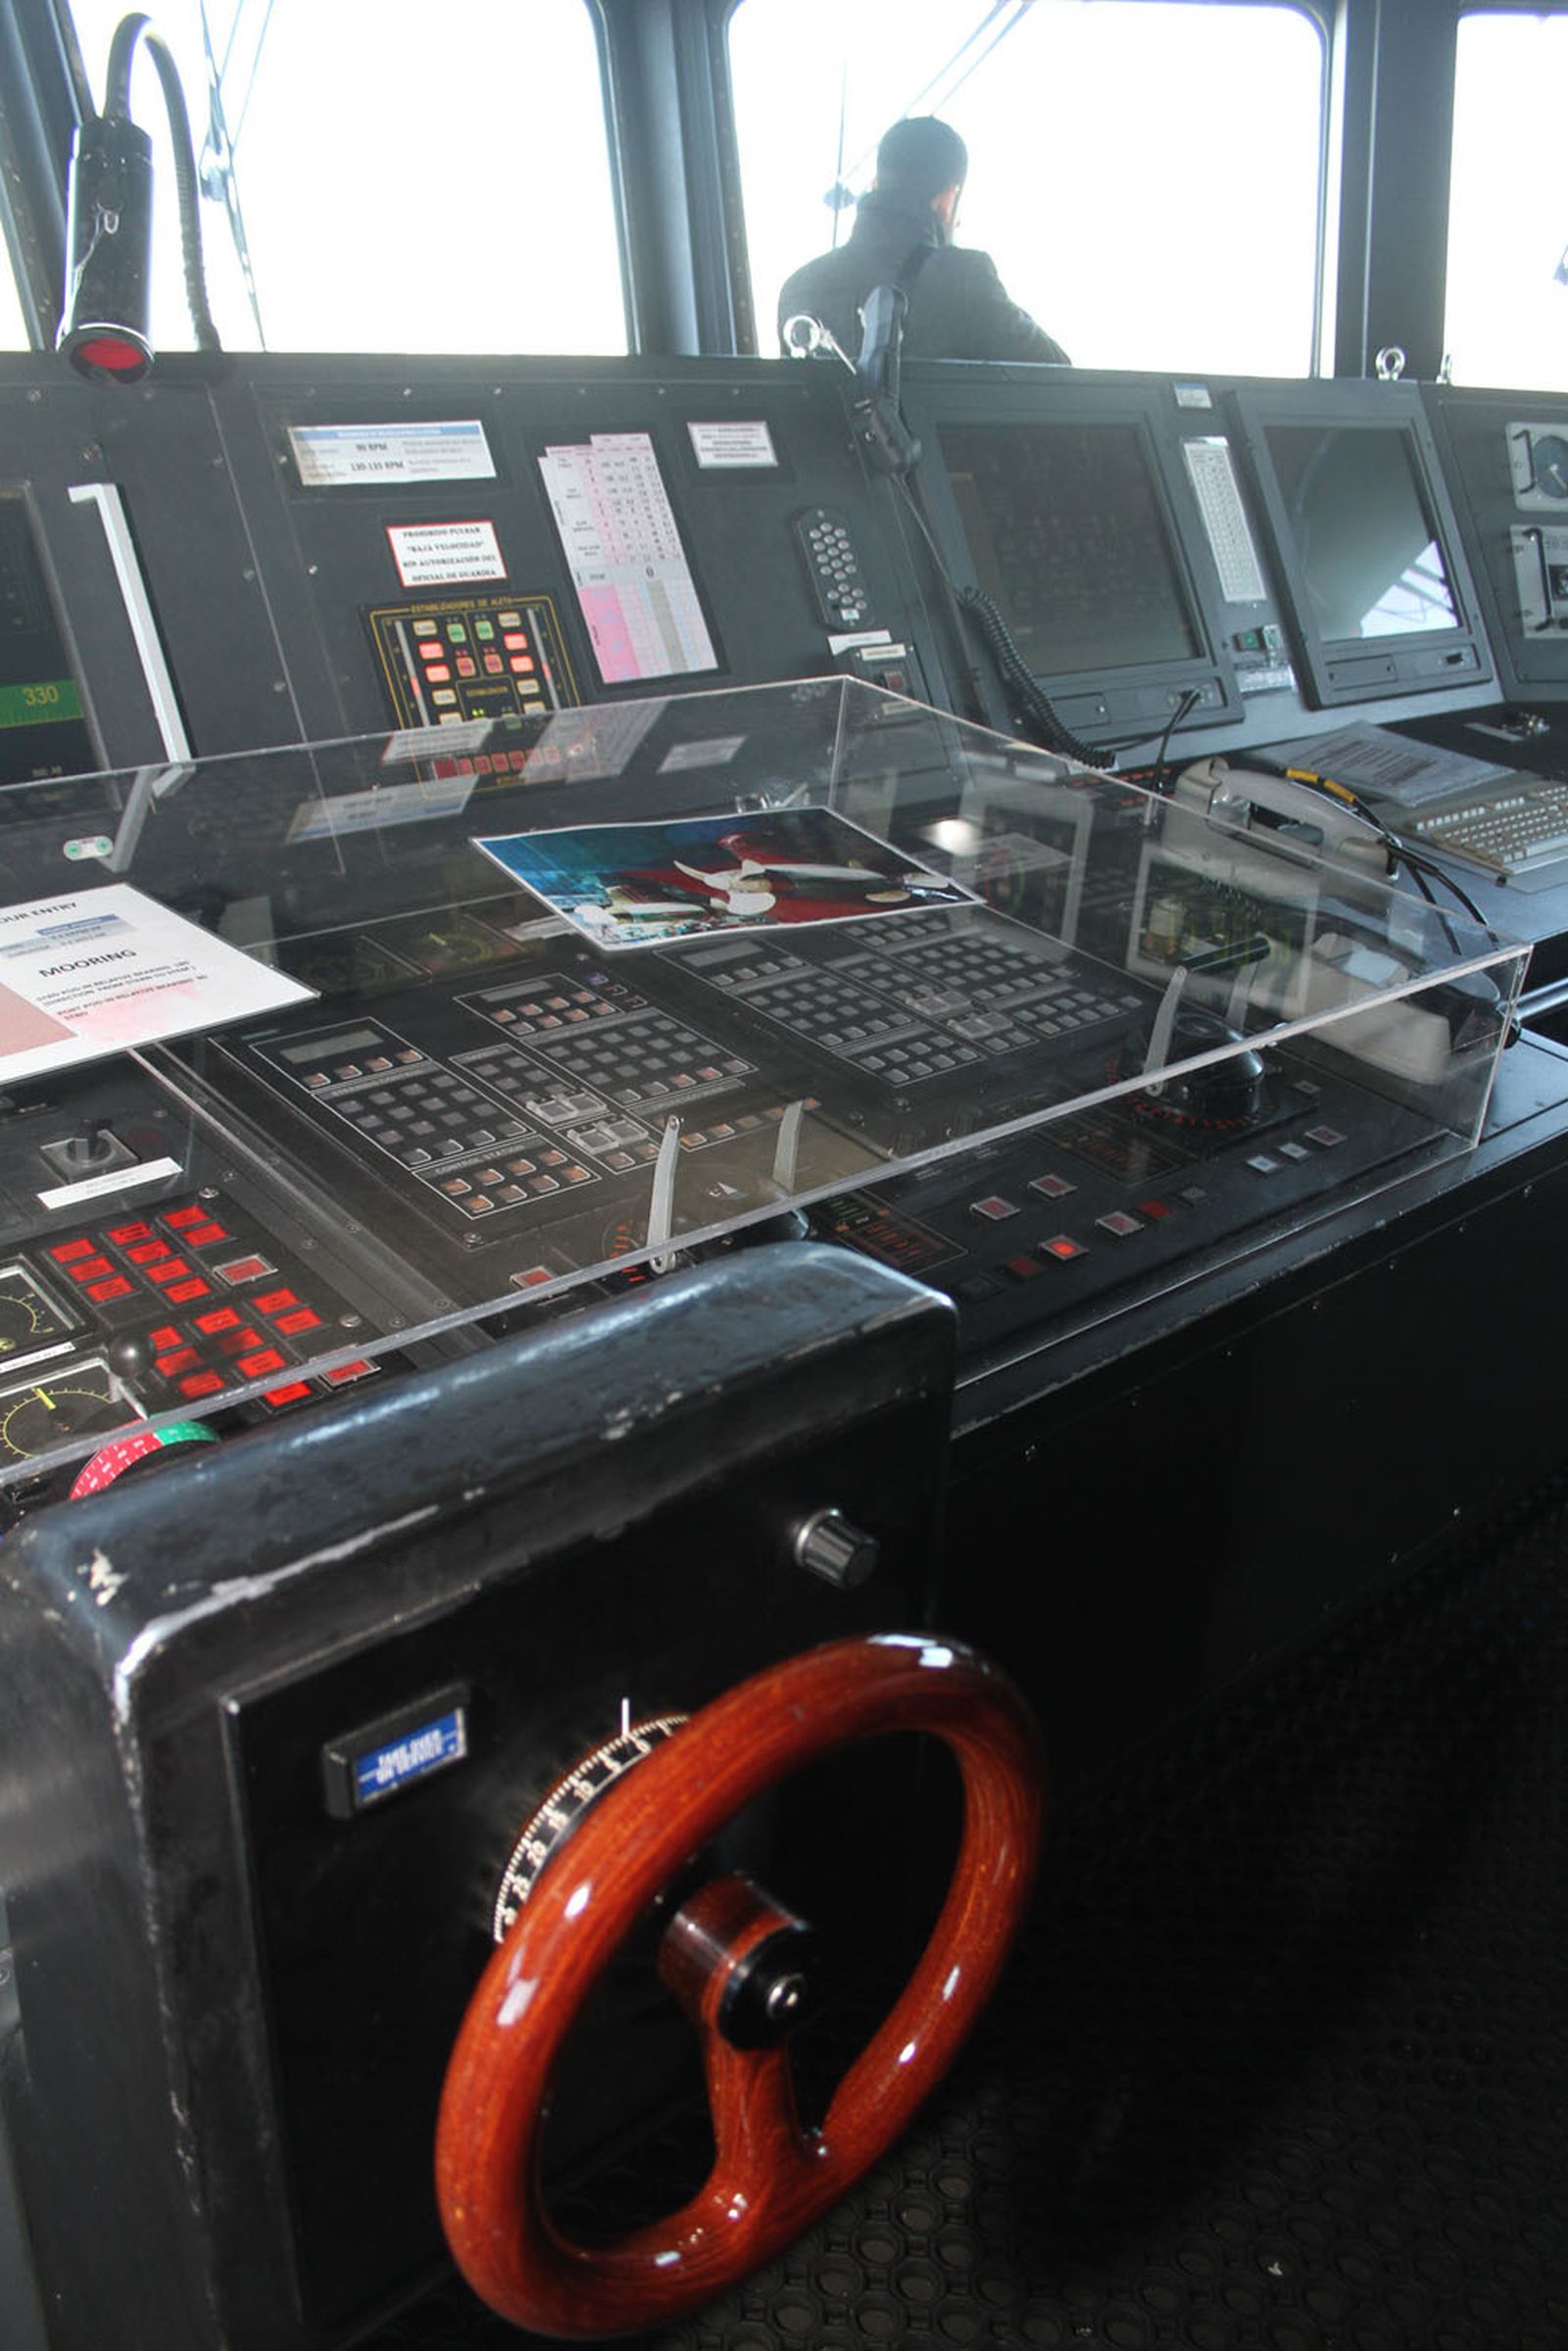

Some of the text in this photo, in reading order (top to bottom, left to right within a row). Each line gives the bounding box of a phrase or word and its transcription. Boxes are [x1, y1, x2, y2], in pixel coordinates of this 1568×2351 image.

[23, 685, 60, 707] 330
[30, 901, 77, 917] ENTRY
[39, 949, 137, 978] MOORING
[573, 1780, 595, 1801] 10
[526, 1839, 548, 1867] 20
[512, 1874, 532, 1903] 25
